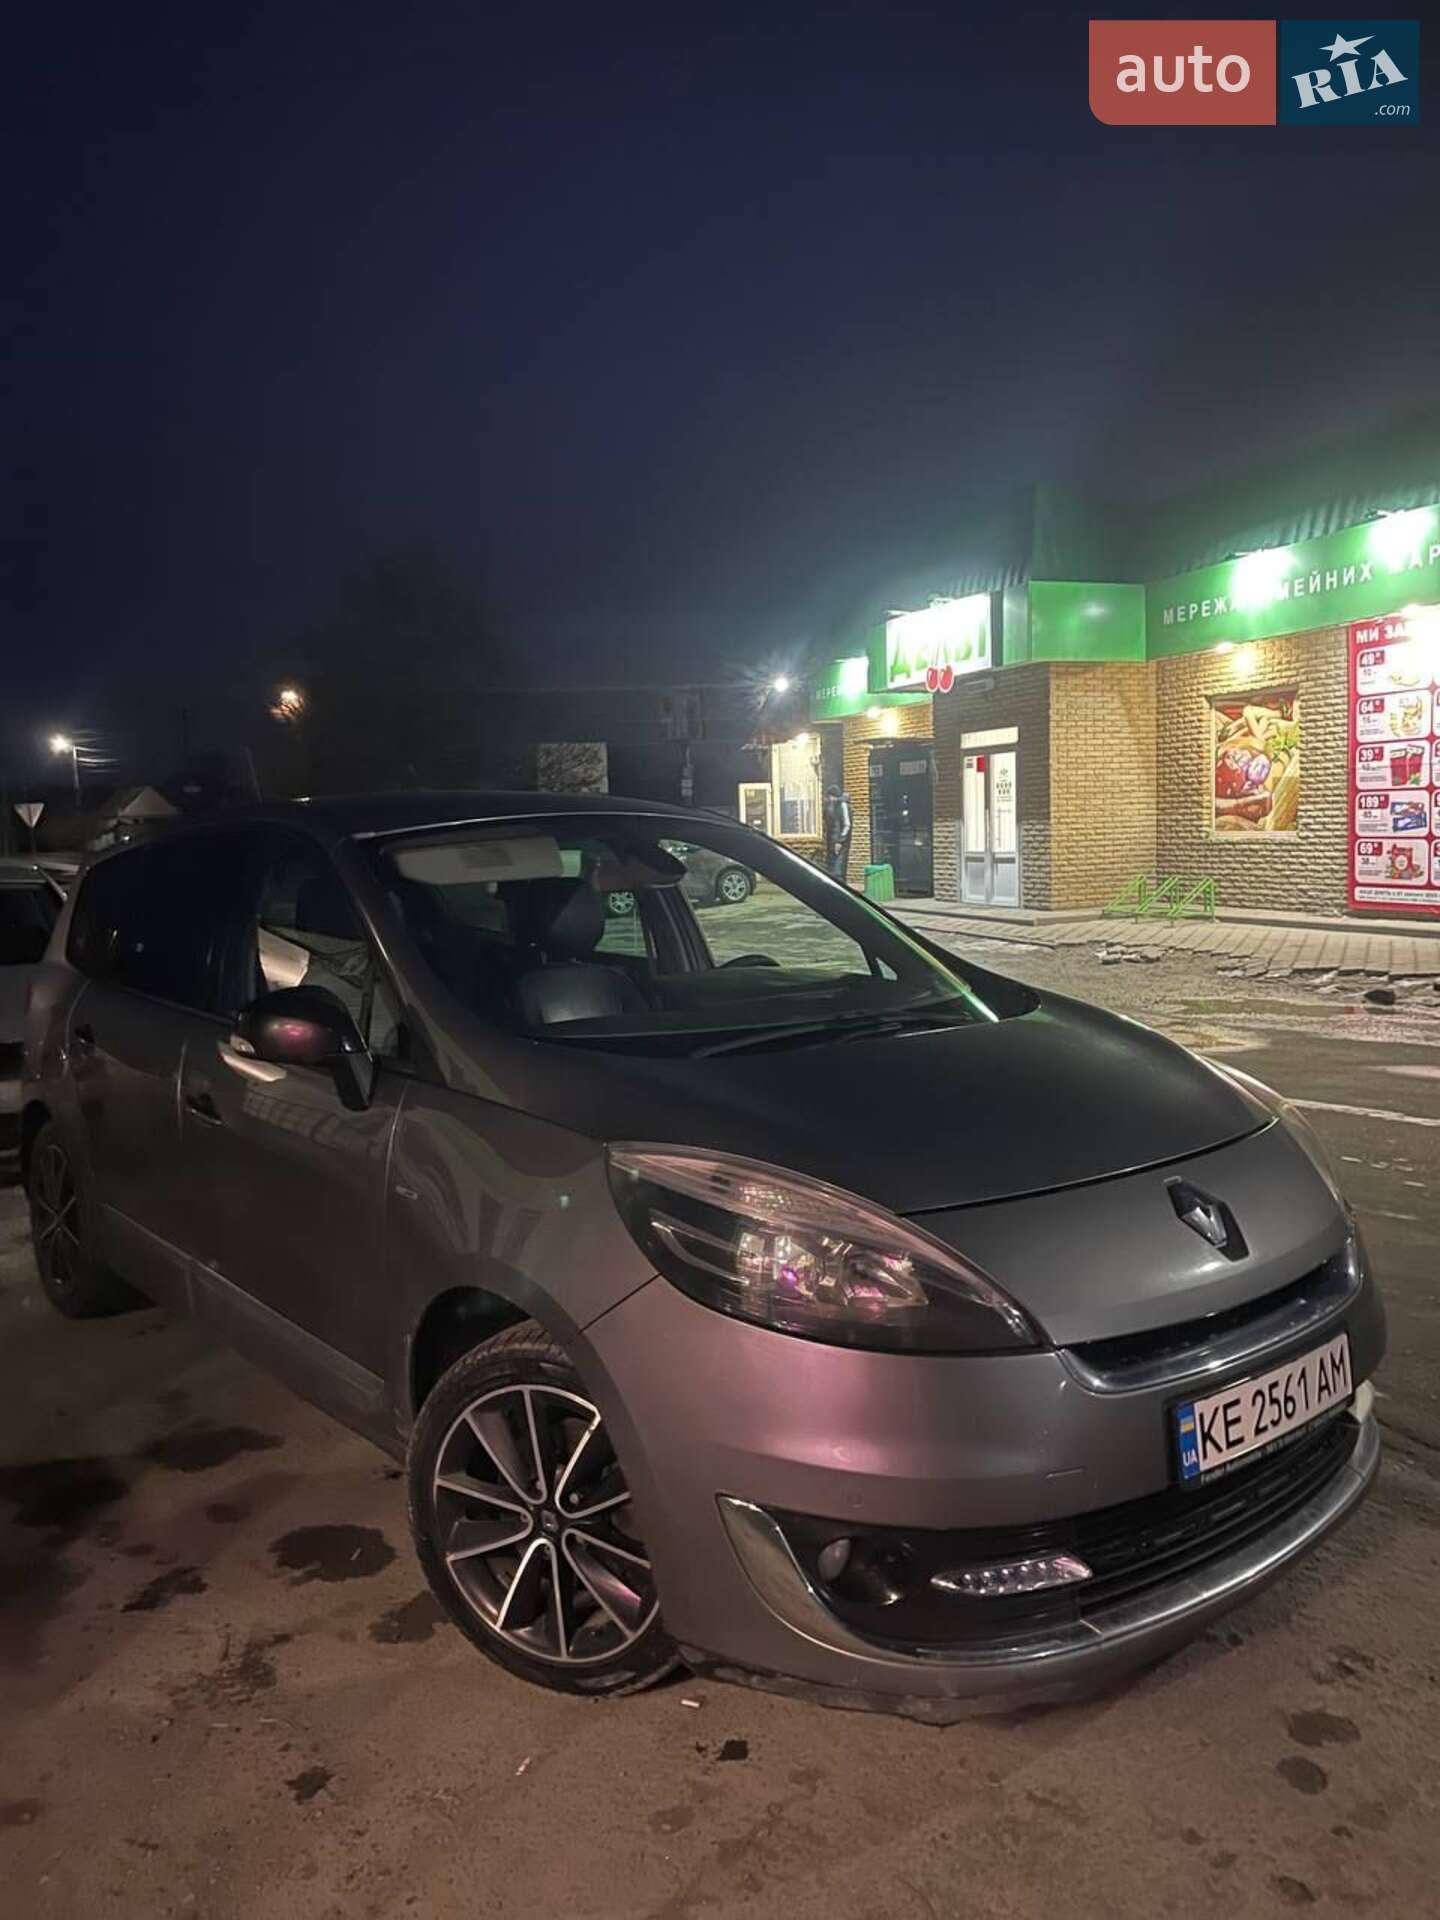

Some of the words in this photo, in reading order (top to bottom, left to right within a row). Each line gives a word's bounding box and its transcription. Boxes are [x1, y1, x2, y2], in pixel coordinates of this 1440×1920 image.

[1360, 842, 1373, 854] 69
[1199, 1398, 1245, 1460] KE
[1251, 1366, 1309, 1437] 2561
[1317, 1344, 1347, 1403] AM
[1182, 1450, 1198, 1467] UA
